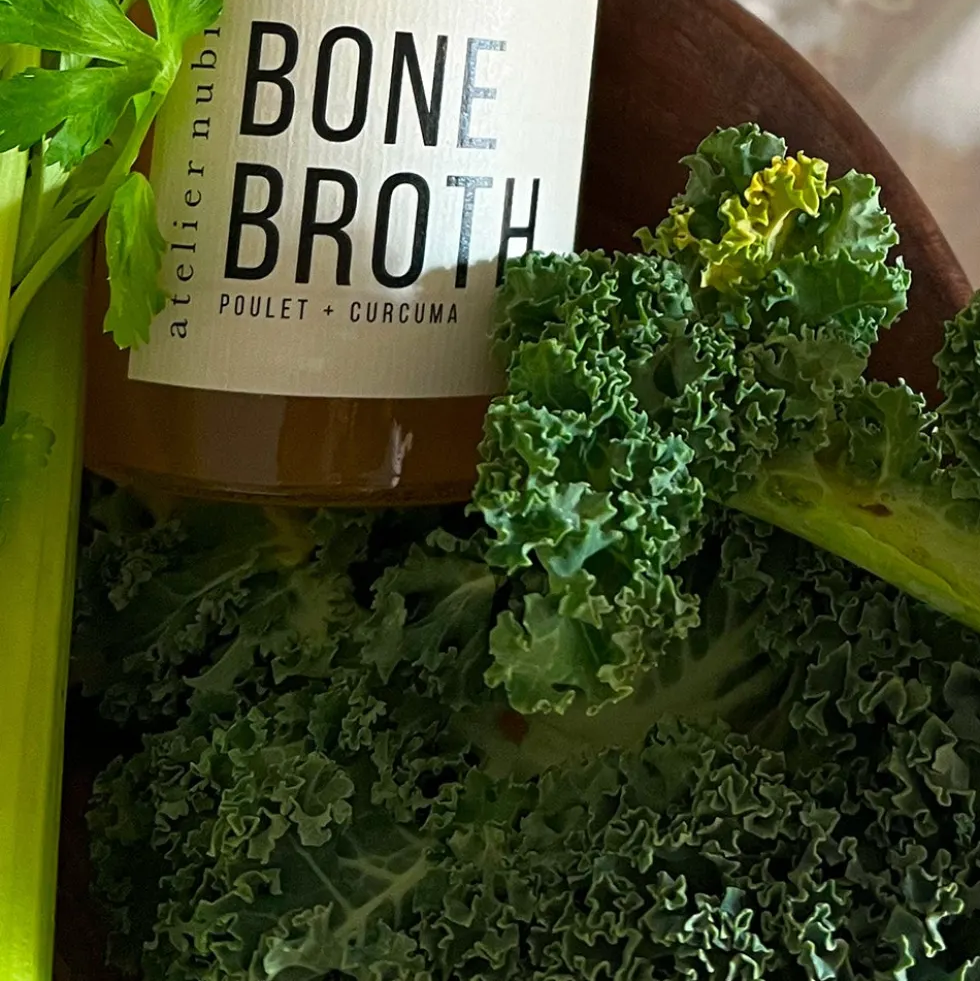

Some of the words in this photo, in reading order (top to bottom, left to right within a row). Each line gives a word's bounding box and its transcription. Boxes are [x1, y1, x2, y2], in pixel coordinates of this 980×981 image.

[239, 21, 507, 150] BONE
[170, 160, 205, 338] atelier
[223, 162, 541, 289] BROTH
[219, 293, 309, 320] POULET
[323, 305, 334, 316] +
[350, 301, 458, 324] CURCUMA
